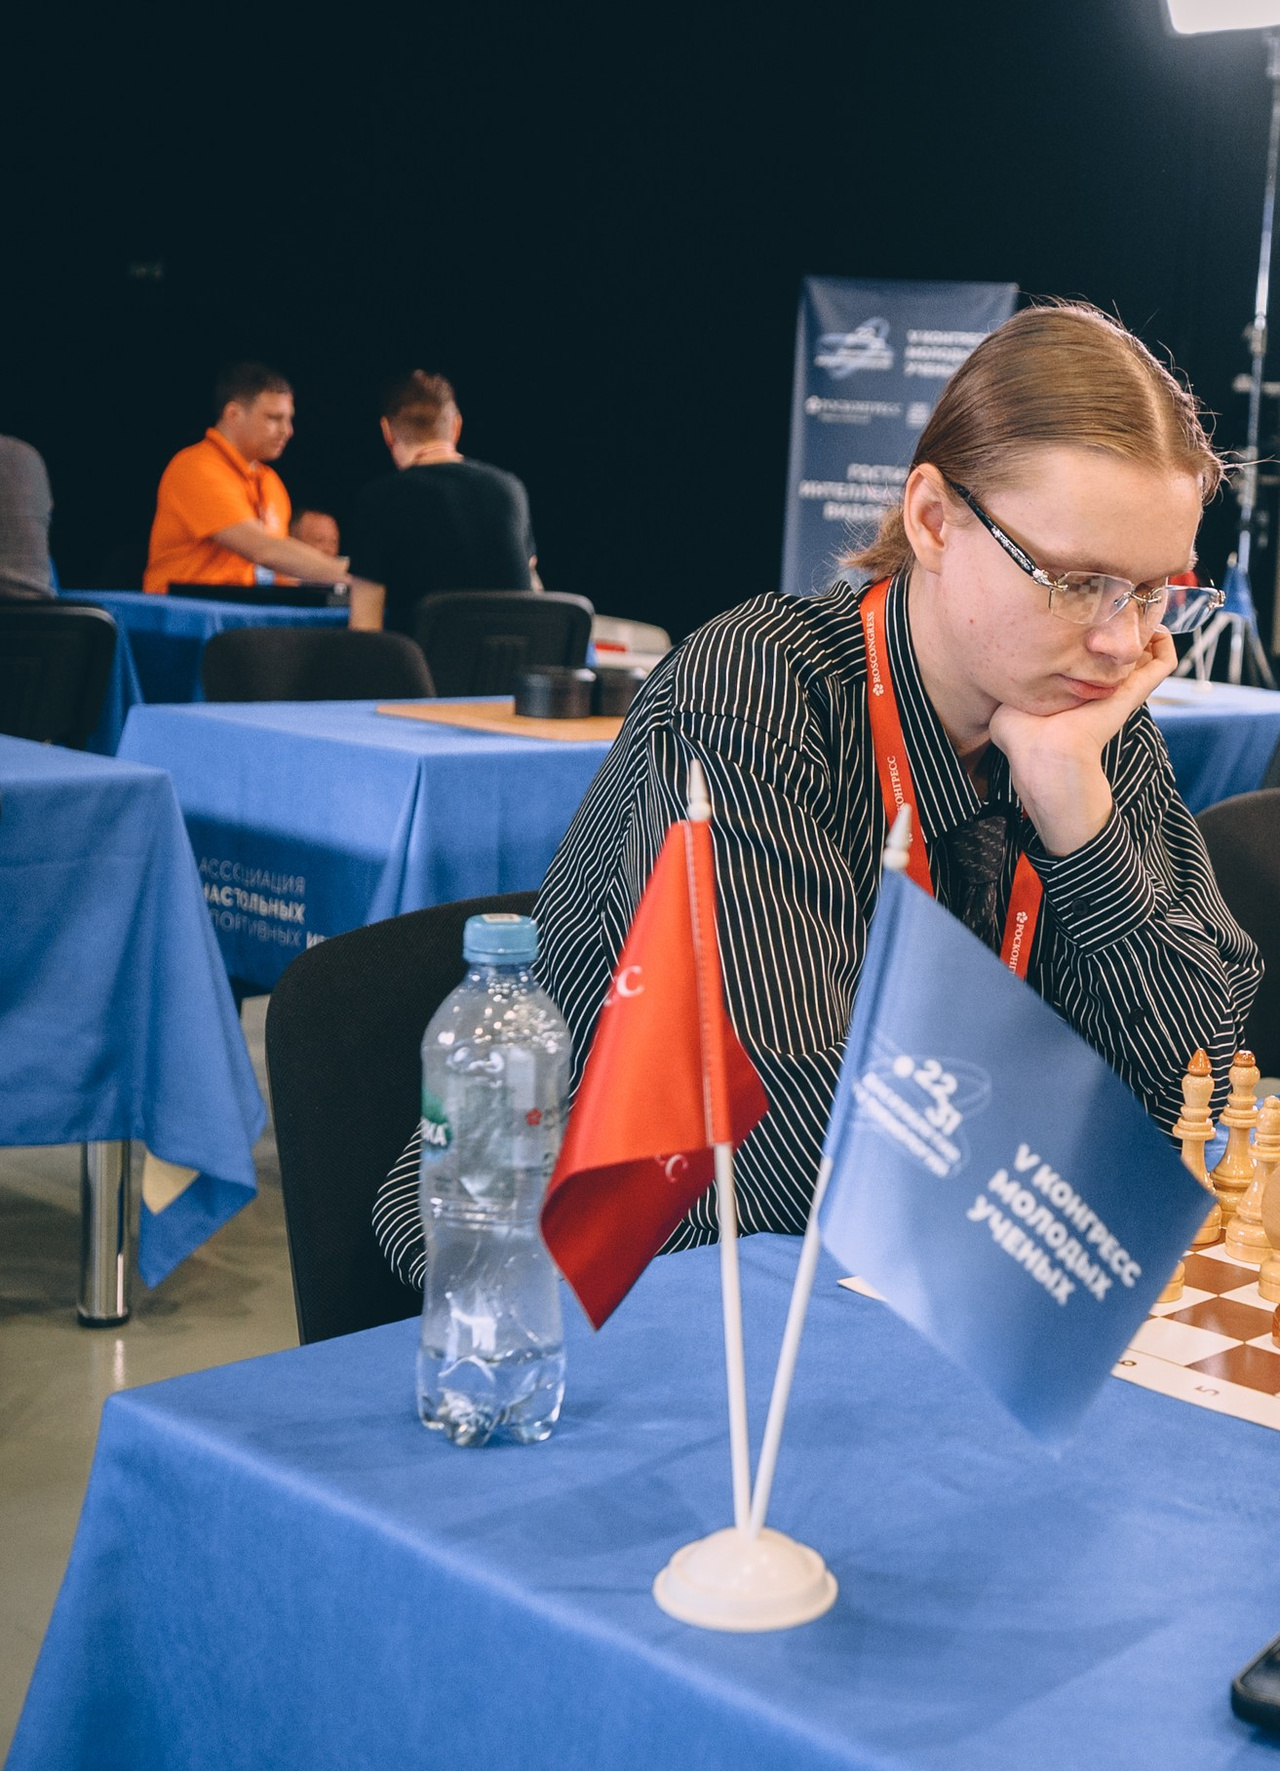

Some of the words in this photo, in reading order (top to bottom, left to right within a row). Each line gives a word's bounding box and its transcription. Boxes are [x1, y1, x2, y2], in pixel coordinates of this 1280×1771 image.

[866, 611, 882, 683] ROSCONGRESS
[966, 1194, 1076, 1307] УЧЕНЫХ
[987, 1168, 1113, 1301] МОЛОДЫХ
[1015, 1144, 1041, 1172] V
[1032, 1165, 1141, 1287] КОНГРЕСС
[1195, 1384, 1220, 1397] 5
